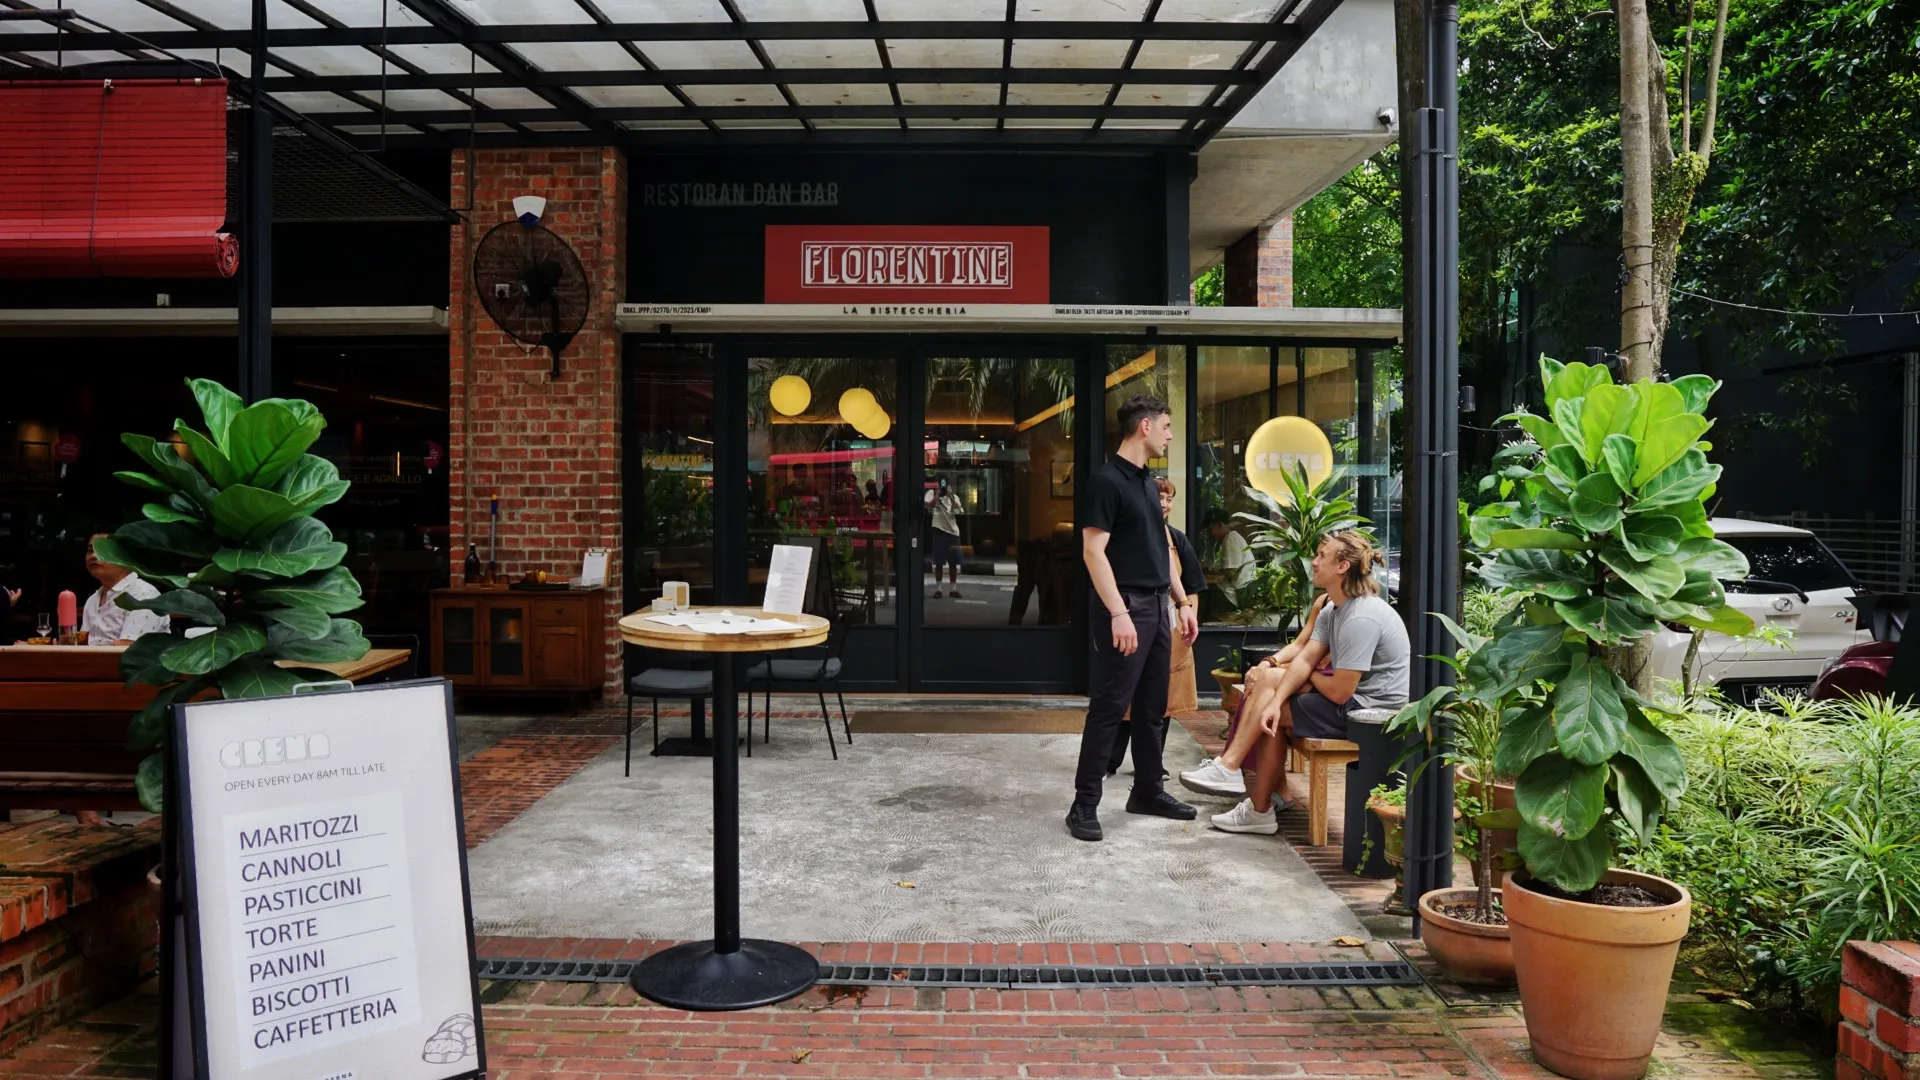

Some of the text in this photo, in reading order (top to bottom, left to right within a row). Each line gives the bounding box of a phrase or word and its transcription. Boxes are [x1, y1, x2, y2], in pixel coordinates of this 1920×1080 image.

[643, 181, 839, 206] RESTORAN DAN BAR
[804, 245, 1009, 285] FLORENTINE
[843, 306, 967, 315] LA BISTECCHERIA
[1254, 451, 1324, 471] CREMA
[220, 731, 331, 770] CREMA
[224, 763, 386, 792] OPEN EVERY DAY 8AM TILL LATE
[240, 814, 359, 850] MARITOZZI
[242, 849, 341, 882] CANNOLI
[244, 877, 362, 916] PASTICCINI
[245, 918, 319, 949] TORTE
[250, 949, 326, 983] PANINI
[252, 975, 351, 1017] BISCOTTI
[254, 997, 397, 1050] CAFFETTERIA
